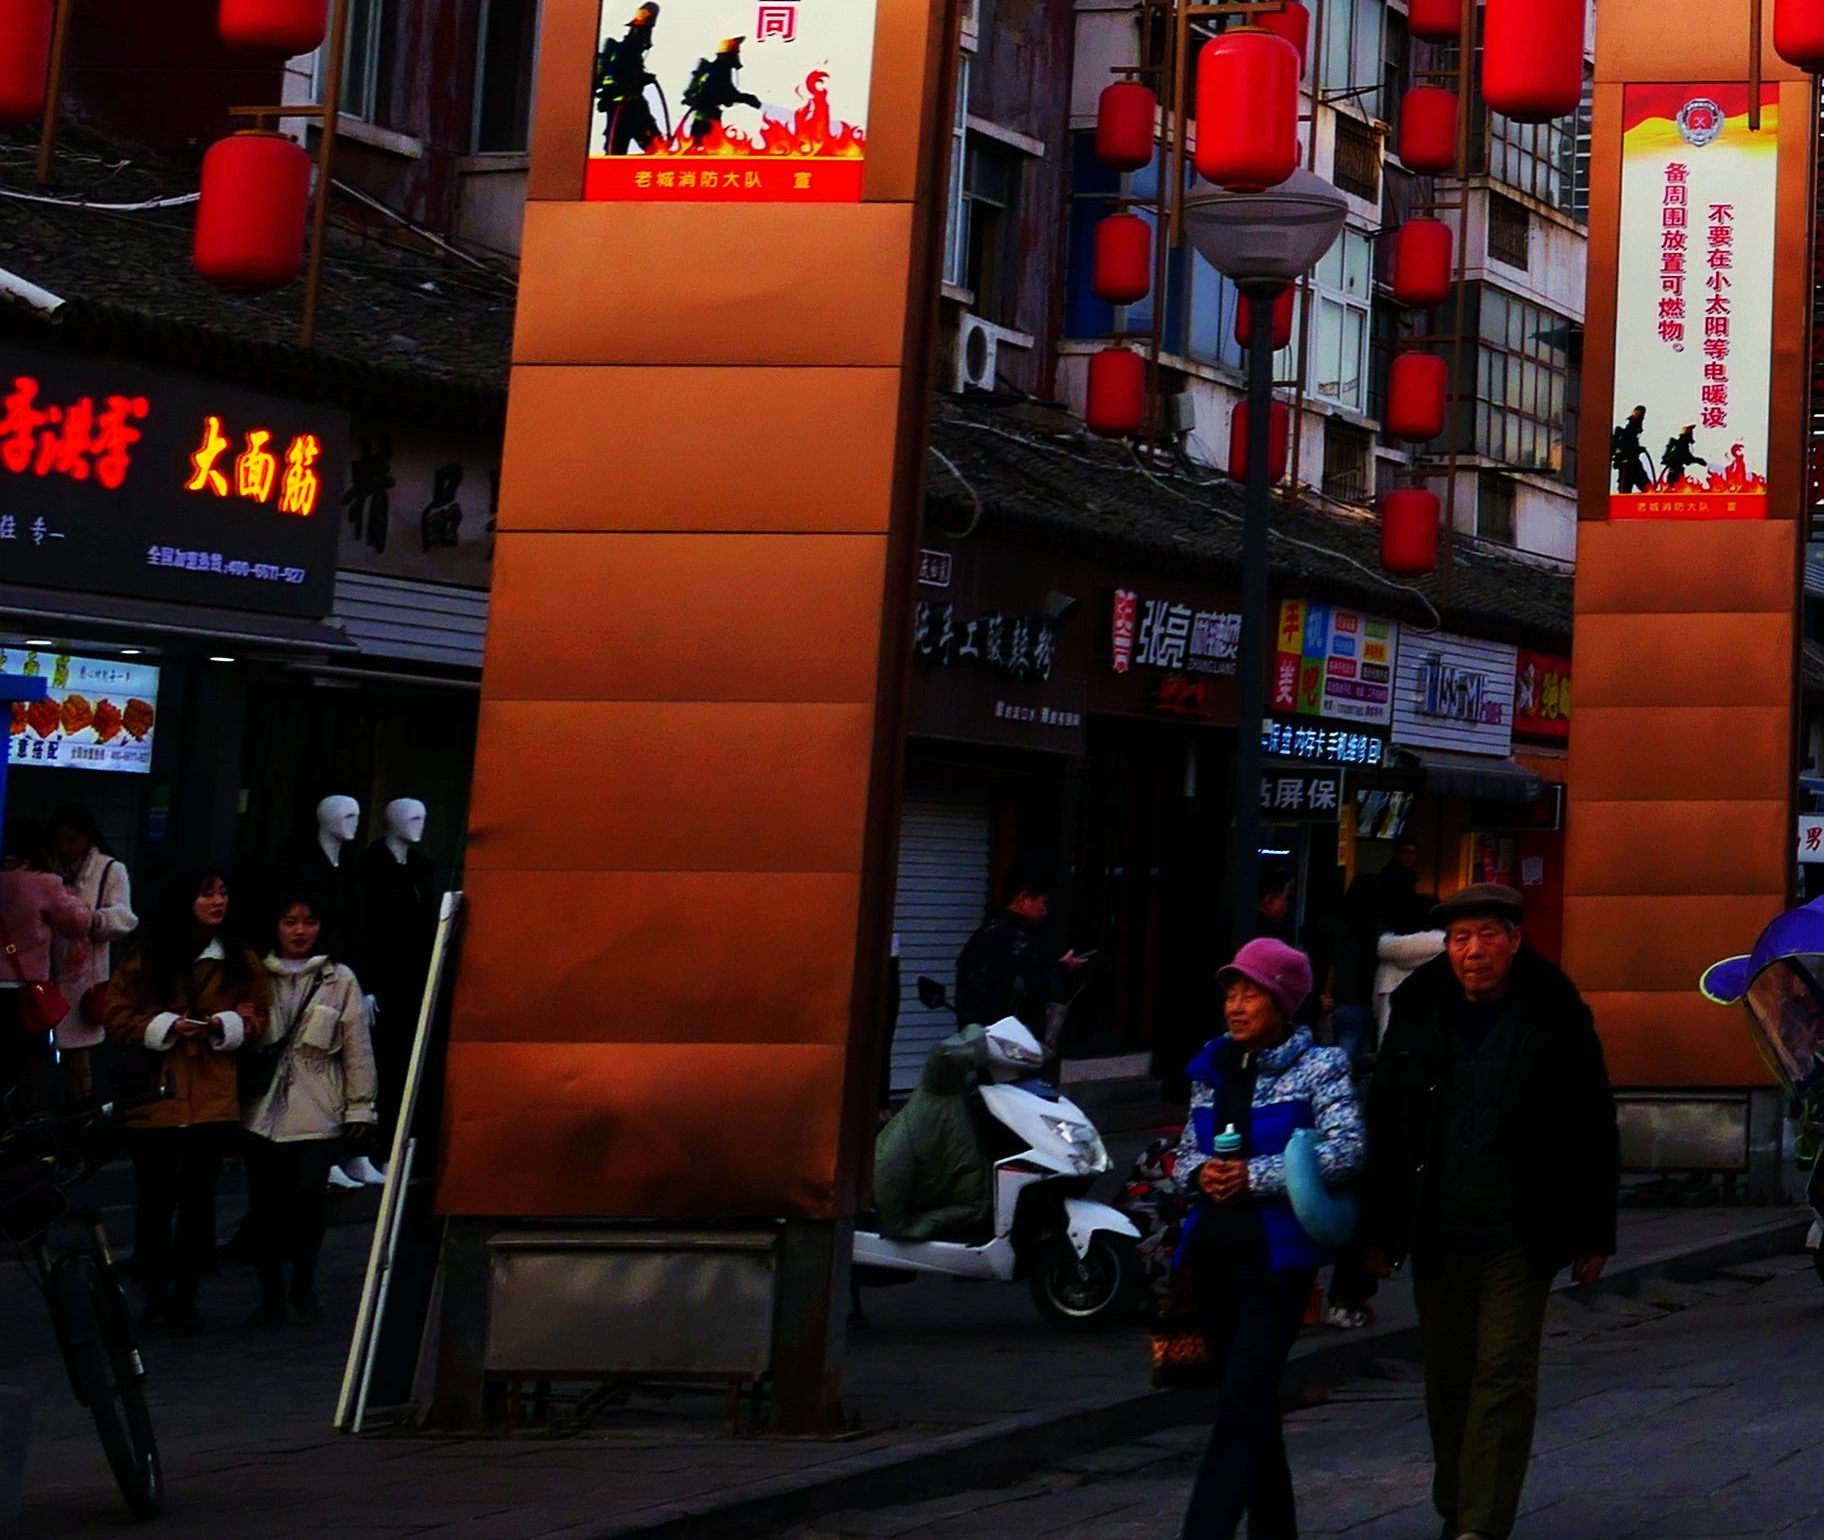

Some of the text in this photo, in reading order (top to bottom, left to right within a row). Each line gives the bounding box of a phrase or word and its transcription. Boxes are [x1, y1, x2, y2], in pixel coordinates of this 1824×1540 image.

[634, 171, 812, 189] 老城消防大队 宣
[1658, 162, 1688, 352] 备周围放置可燃物。
[1700, 204, 1734, 428] 不要在小太阳等电暖设
[186, 415, 320, 517] 大面筋
[340, 433, 498, 553] 精品
[1636, 501, 1710, 512] 老城消防大队
